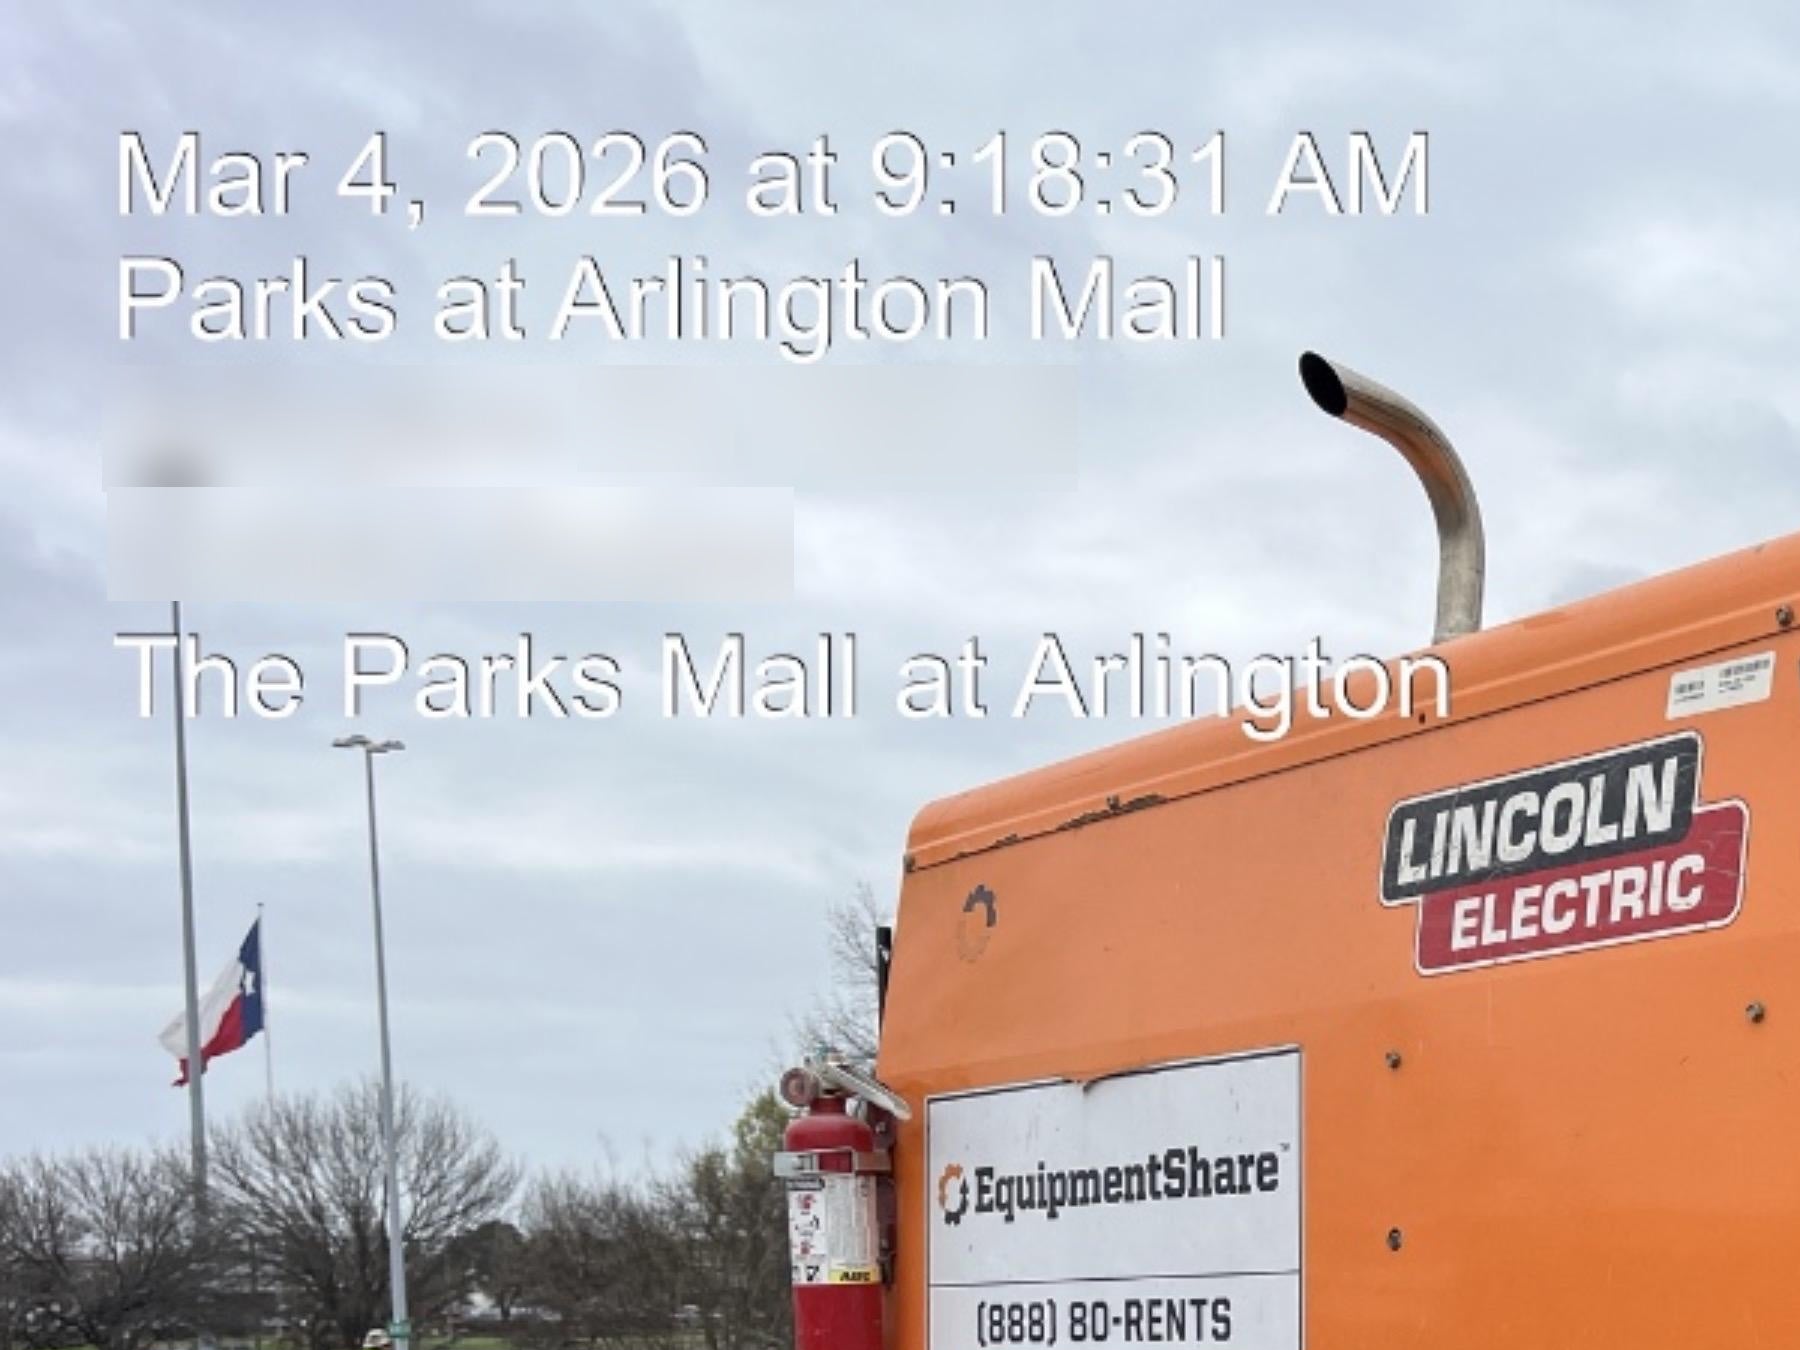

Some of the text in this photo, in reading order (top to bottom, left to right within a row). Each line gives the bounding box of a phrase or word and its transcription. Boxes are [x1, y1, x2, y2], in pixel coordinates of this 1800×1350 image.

[1396, 755, 1679, 889] LINCOLN
[1450, 853, 1707, 953] ELECTRIC
[973, 1144, 1280, 1224] EquipmentShare
[976, 1295, 1233, 1348] (888) 80-RENTS
